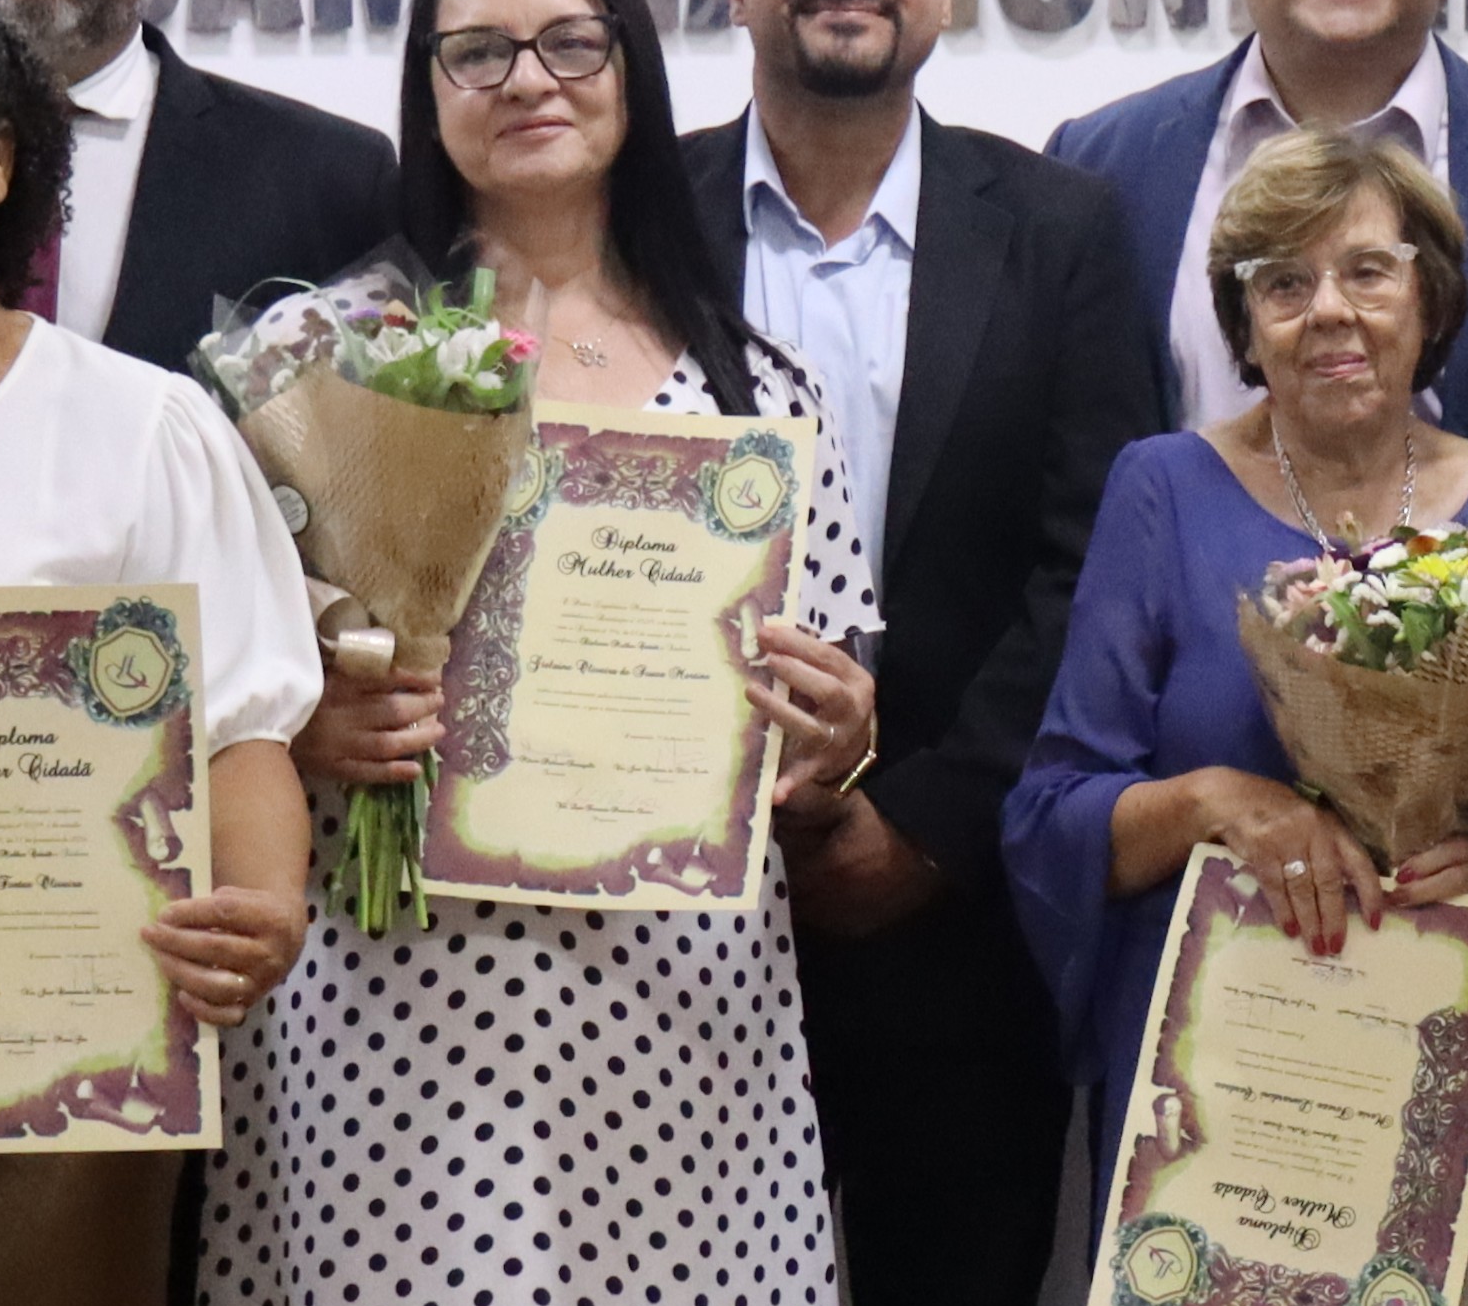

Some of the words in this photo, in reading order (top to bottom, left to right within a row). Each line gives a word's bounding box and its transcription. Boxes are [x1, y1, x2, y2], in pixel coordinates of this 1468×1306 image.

[591, 525, 678, 554] Diploma
[557, 551, 636, 581] Mulher
[639, 558, 705, 586] Cidadã
[17, 752, 94, 783] Cidadã
[1282, 1195, 1357, 1227] Mulher
[1237, 1214, 1321, 1249] Diploma
